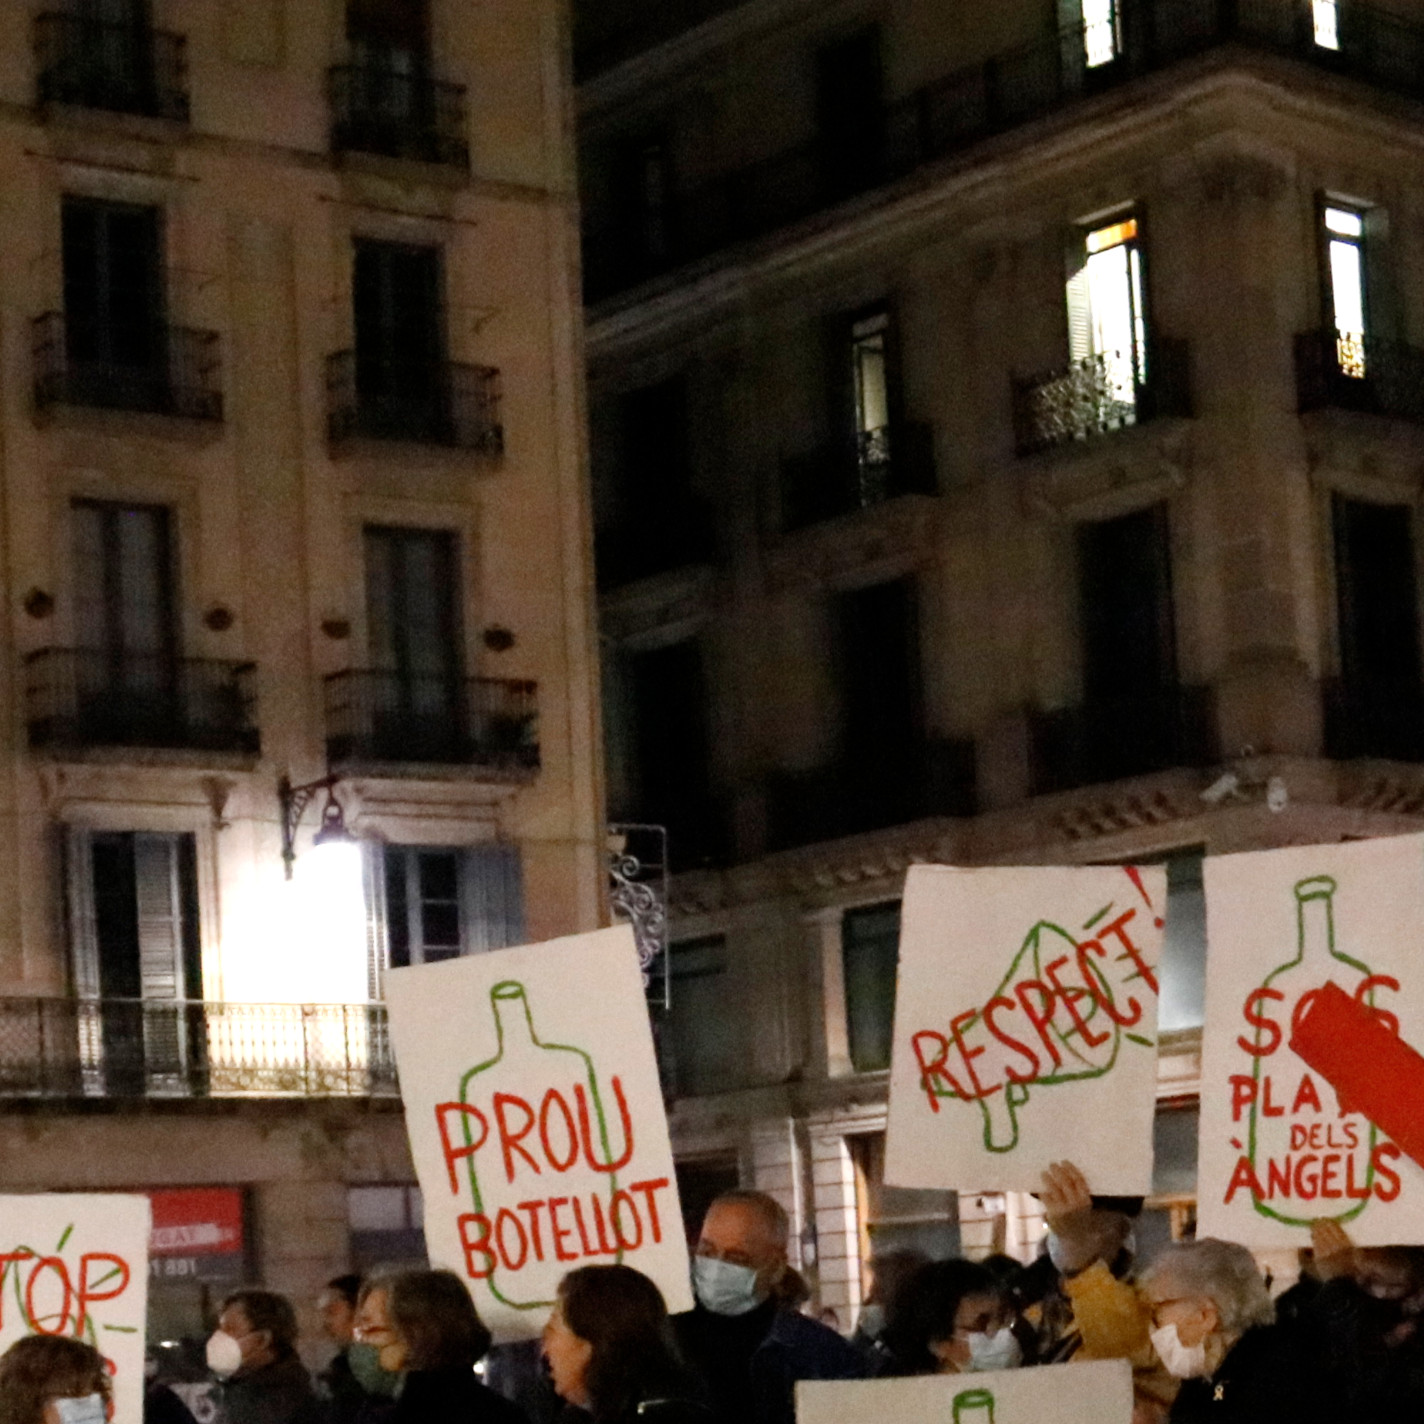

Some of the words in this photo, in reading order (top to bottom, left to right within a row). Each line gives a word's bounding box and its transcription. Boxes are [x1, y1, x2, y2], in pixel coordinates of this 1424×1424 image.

[434, 1075, 636, 1195] PROU
[1222, 1137, 1402, 1206] ÀNGELS
[1289, 1122, 1360, 1151] DELS
[457, 1177, 670, 1280] BOTELLOT
